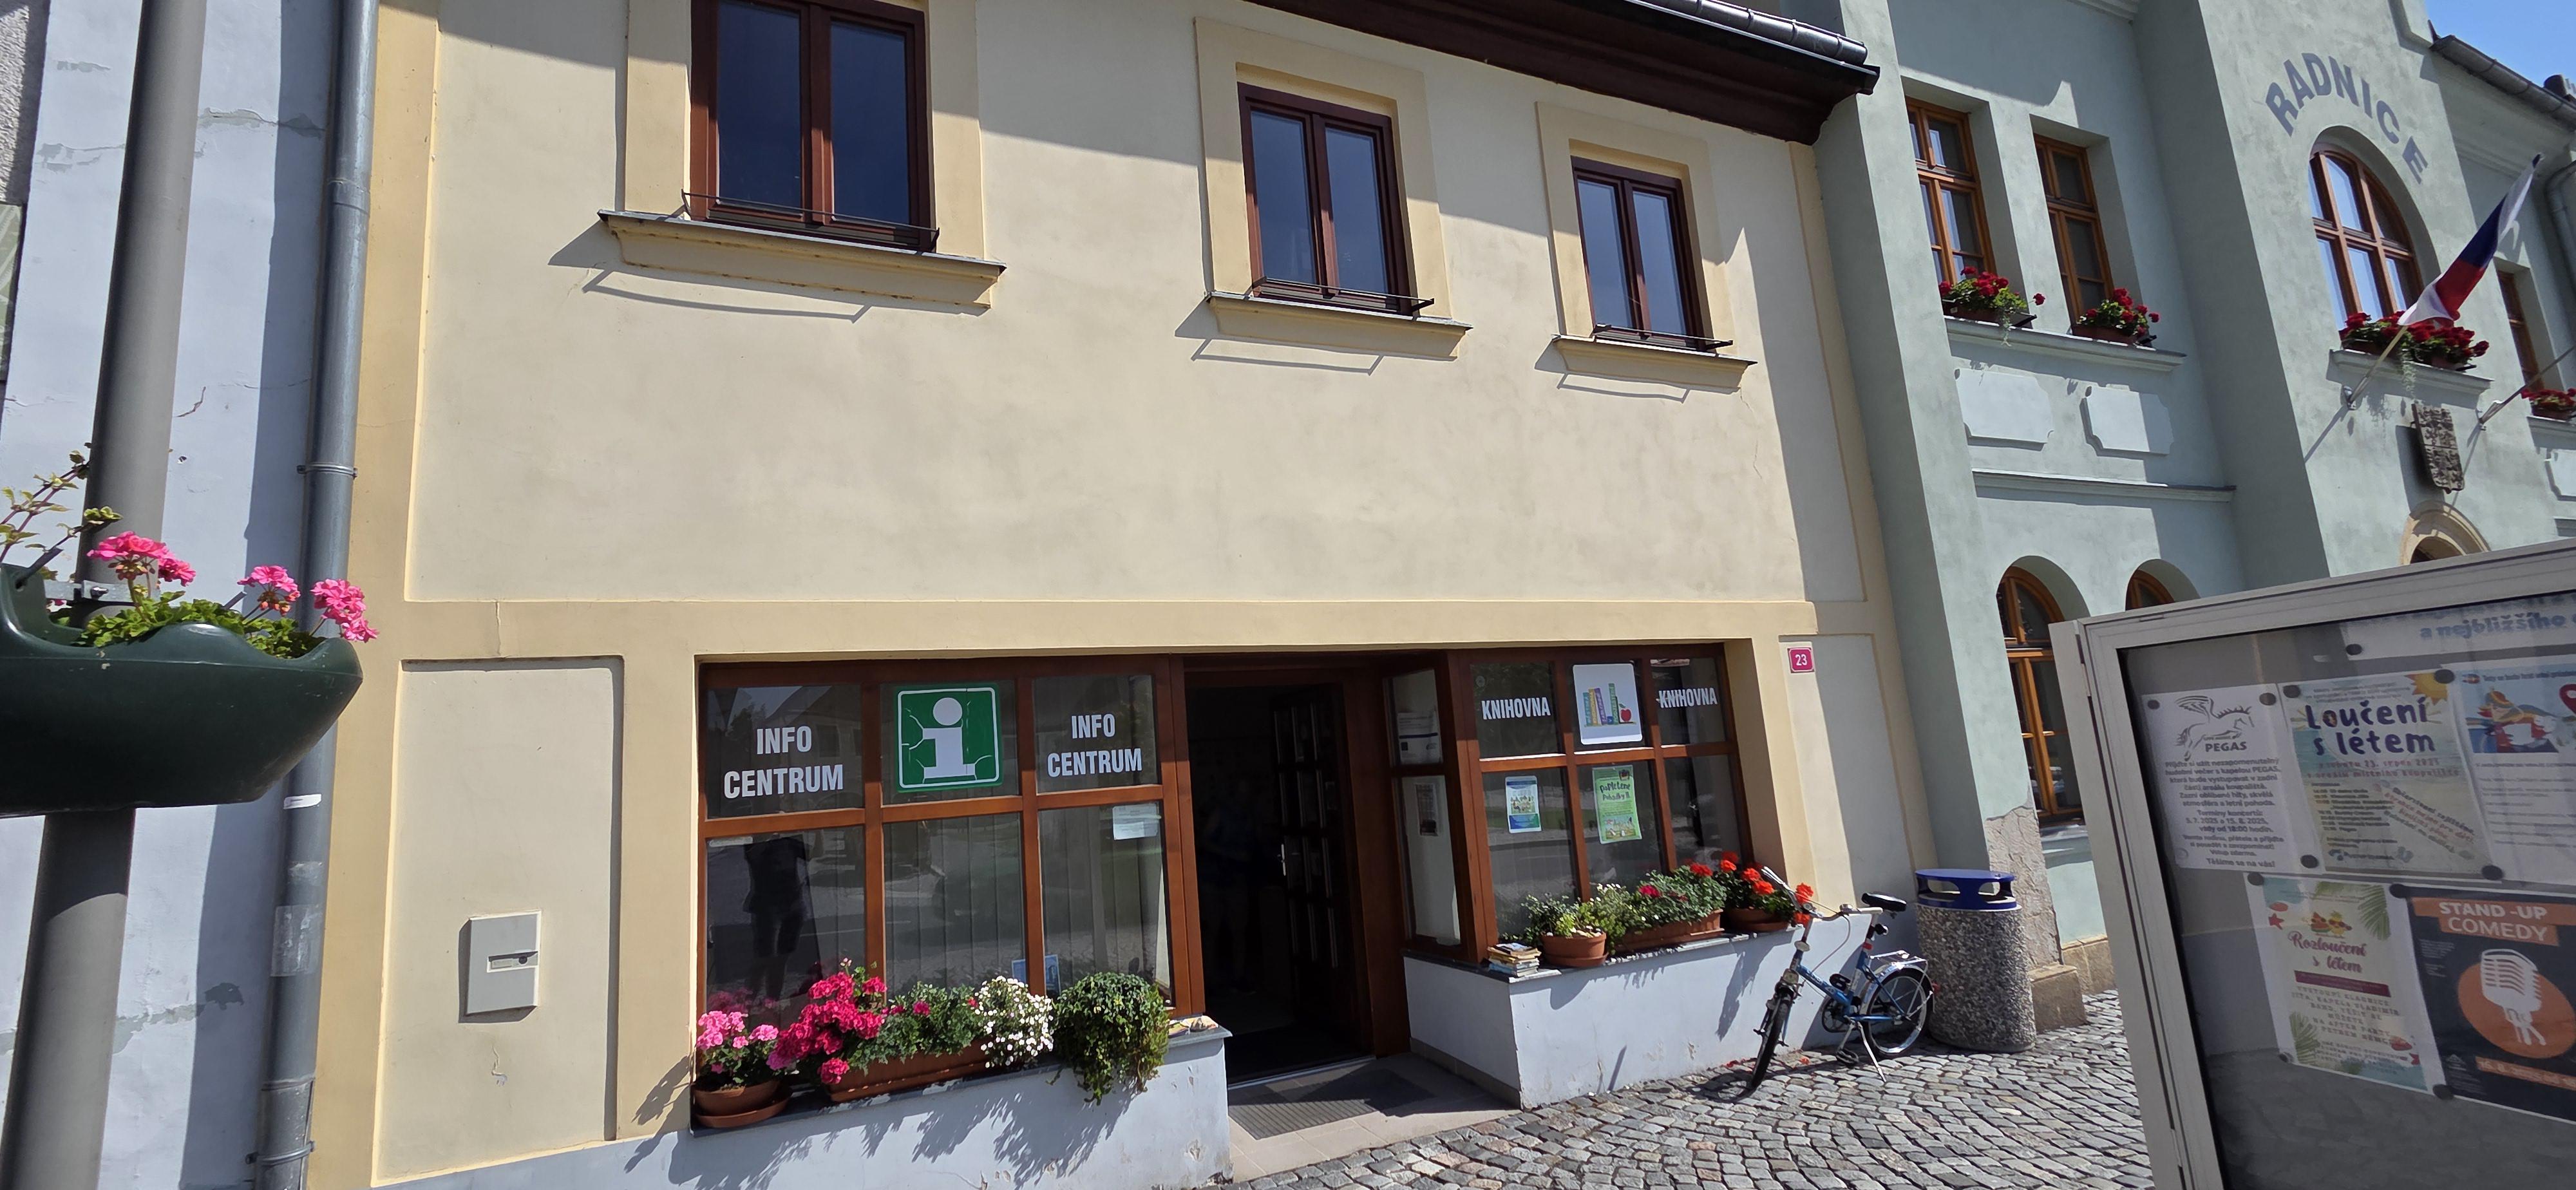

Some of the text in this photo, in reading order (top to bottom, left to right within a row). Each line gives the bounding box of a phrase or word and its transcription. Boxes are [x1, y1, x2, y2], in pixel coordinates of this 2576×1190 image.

[2266, 52, 2428, 184] RADNICE
[2420, 627, 2432, 638] a
[2438, 612, 2566, 639] nejbližšího
[1795, 654, 1808, 666] 23
[1481, 697, 1551, 720] KNIHOVNA
[1658, 688, 1718, 708] KNIHOVNA
[1071, 713, 1116, 739] INFO
[2305, 697, 2427, 730] Loučení
[757, 726, 812, 755] INFO
[2205, 741, 2247, 753] PEGAS
[2313, 727, 2436, 755] s létem
[1047, 748, 1142, 778] CENTRUM
[724, 764, 844, 799] CENTRUM
[2438, 902, 2548, 920] STAND -UP
[2448, 917, 2548, 941] COMEDY
[2287, 930, 2367, 957] Rozloučení
[2327, 955, 2362, 973] létem
